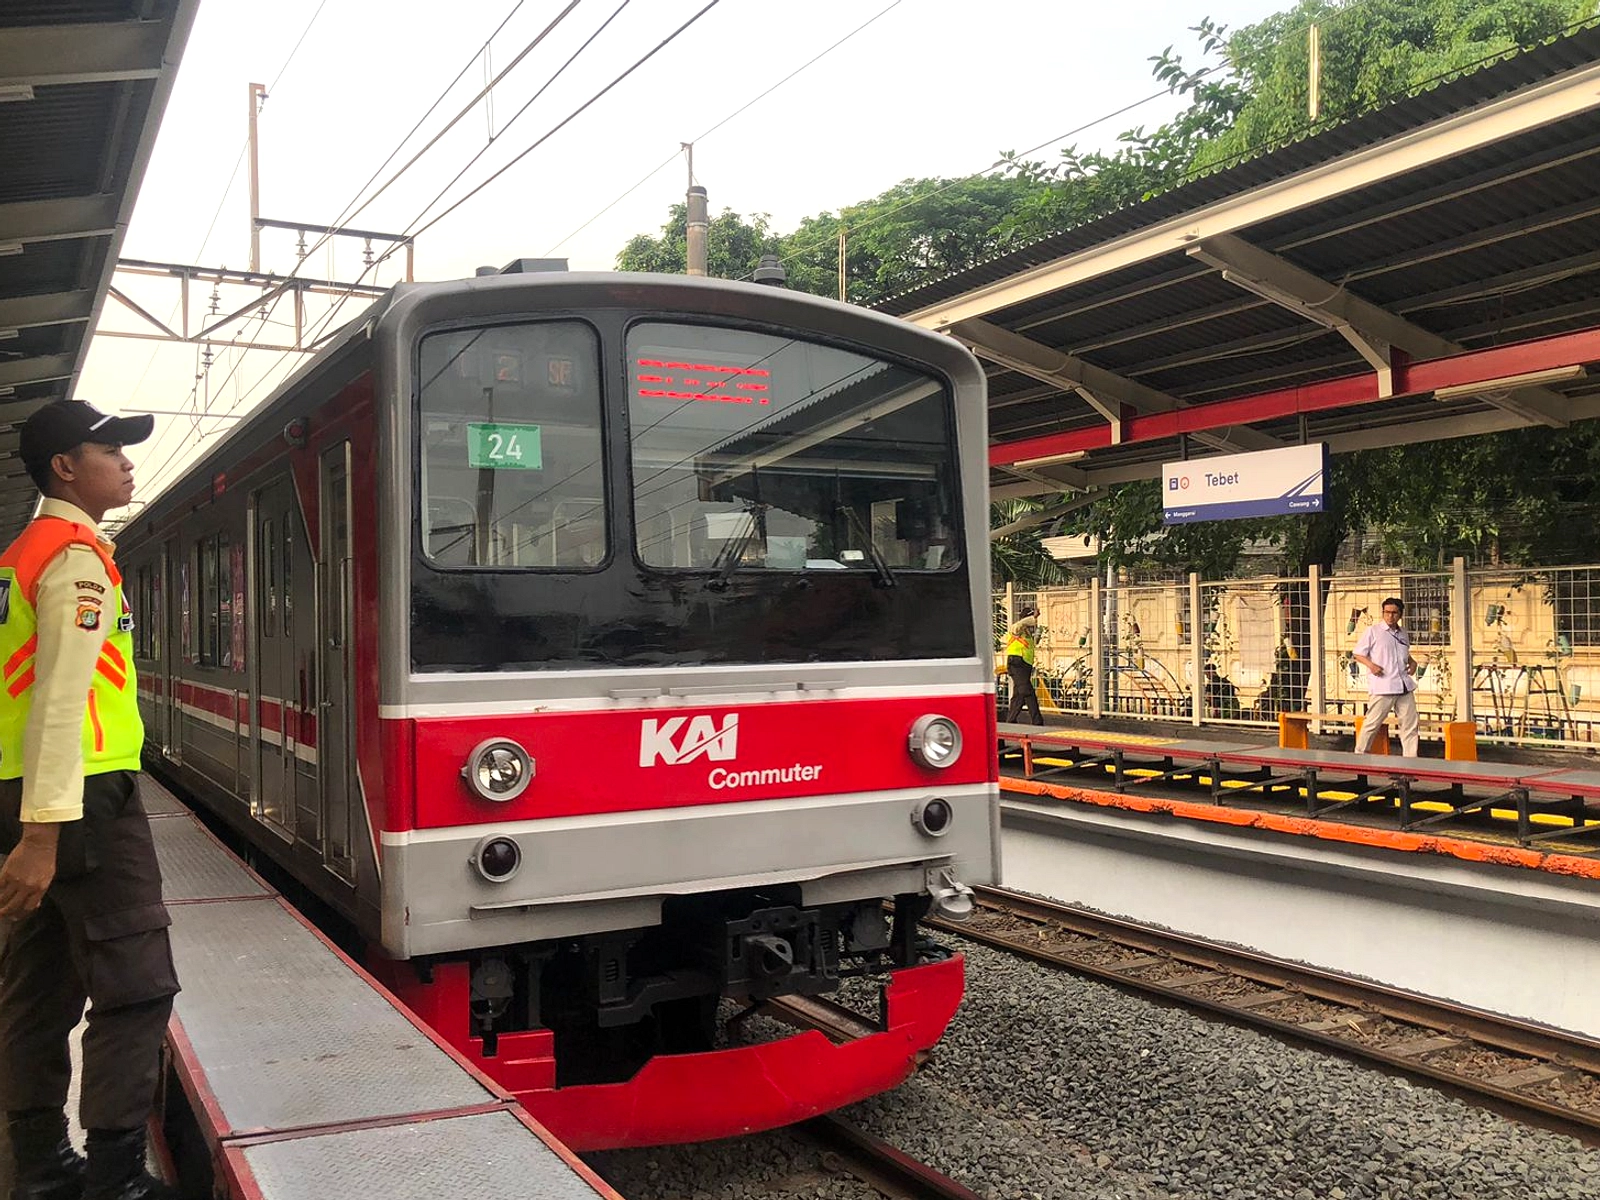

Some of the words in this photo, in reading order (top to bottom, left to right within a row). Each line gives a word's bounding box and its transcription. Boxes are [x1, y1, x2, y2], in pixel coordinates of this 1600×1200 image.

[488, 433, 522, 460] 24
[1205, 472, 1239, 487] Tebet
[78, 581, 103, 592] POLDA
[639, 713, 739, 767] KAI
[708, 763, 822, 790] Commuter
